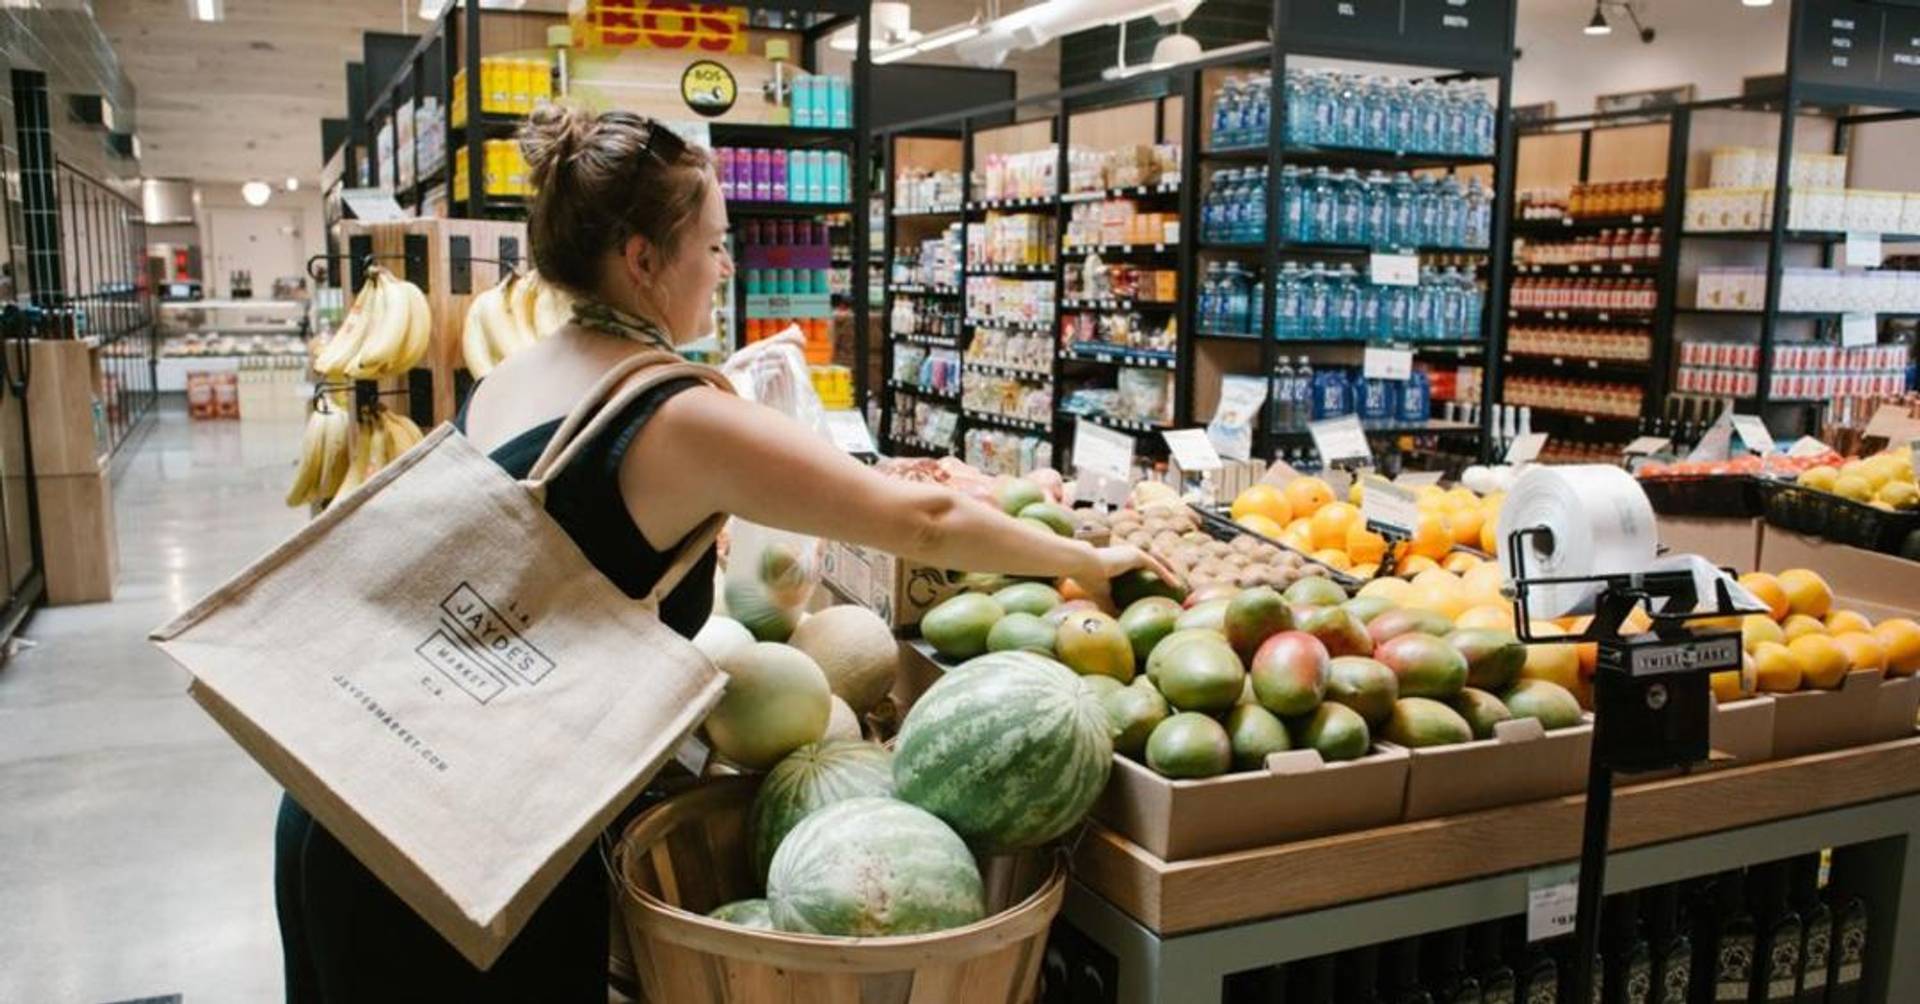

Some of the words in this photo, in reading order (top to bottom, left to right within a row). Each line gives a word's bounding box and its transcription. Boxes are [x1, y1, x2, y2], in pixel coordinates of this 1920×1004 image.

[601, 0, 733, 51] BOS
[694, 70, 722, 82] BOS
[456, 603, 535, 671] JAYDE'S
[438, 647, 488, 688] MARKET
[1641, 653, 1680, 668] TWIST
